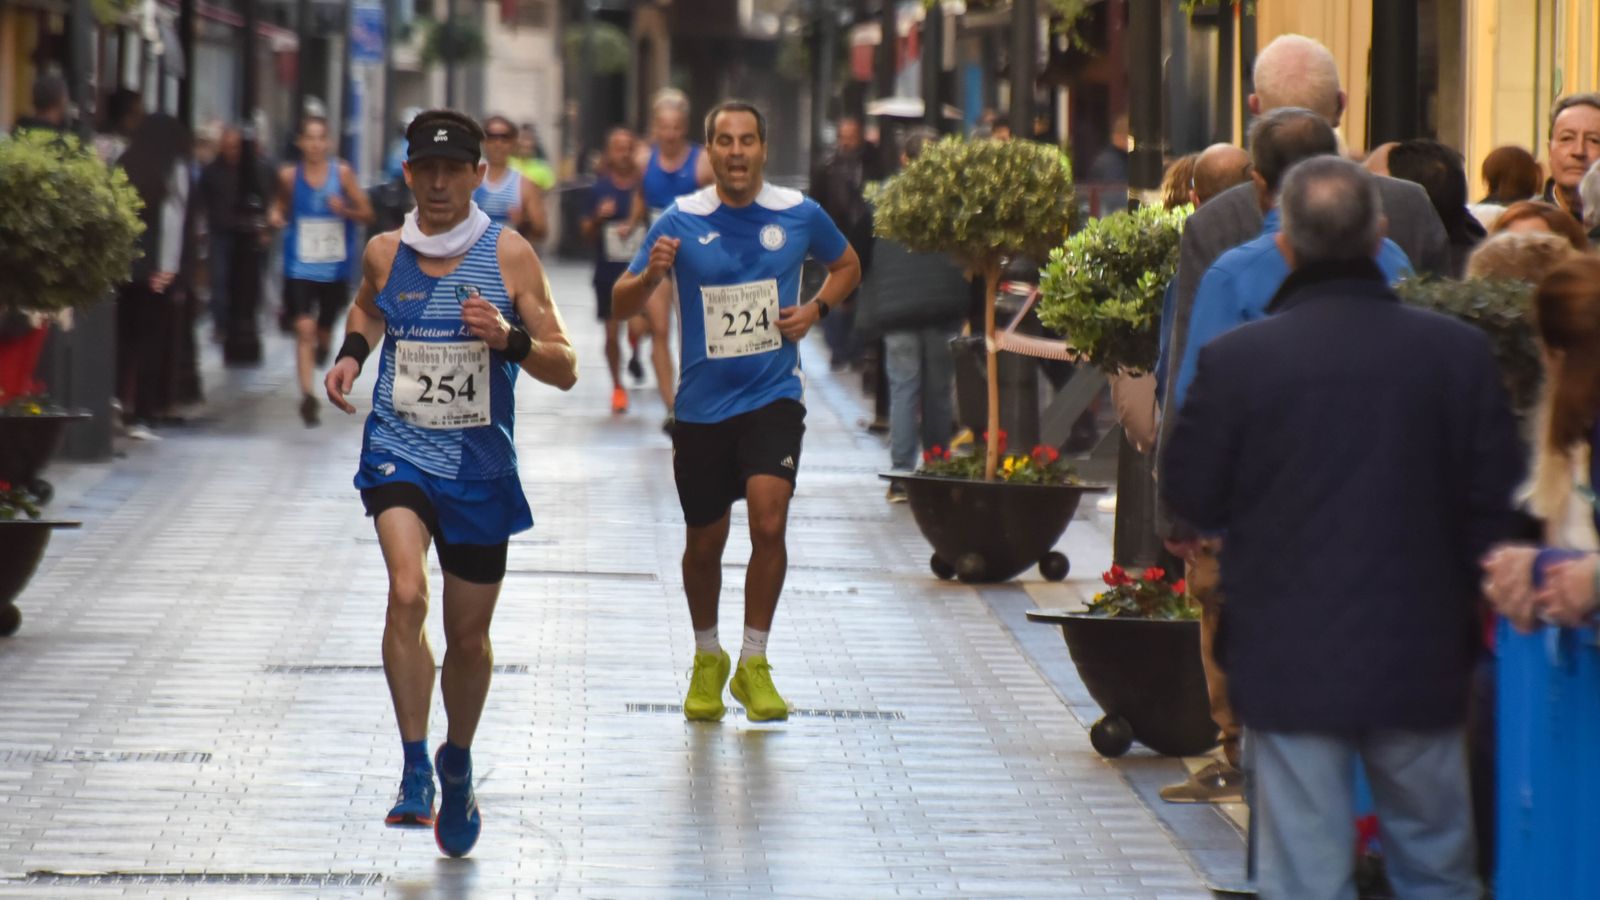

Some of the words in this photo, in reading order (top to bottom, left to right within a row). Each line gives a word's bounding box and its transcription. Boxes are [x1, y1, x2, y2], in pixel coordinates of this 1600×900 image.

[405, 325, 455, 339] Atletismo
[721, 307, 770, 337] 224
[417, 373, 476, 404] 254
